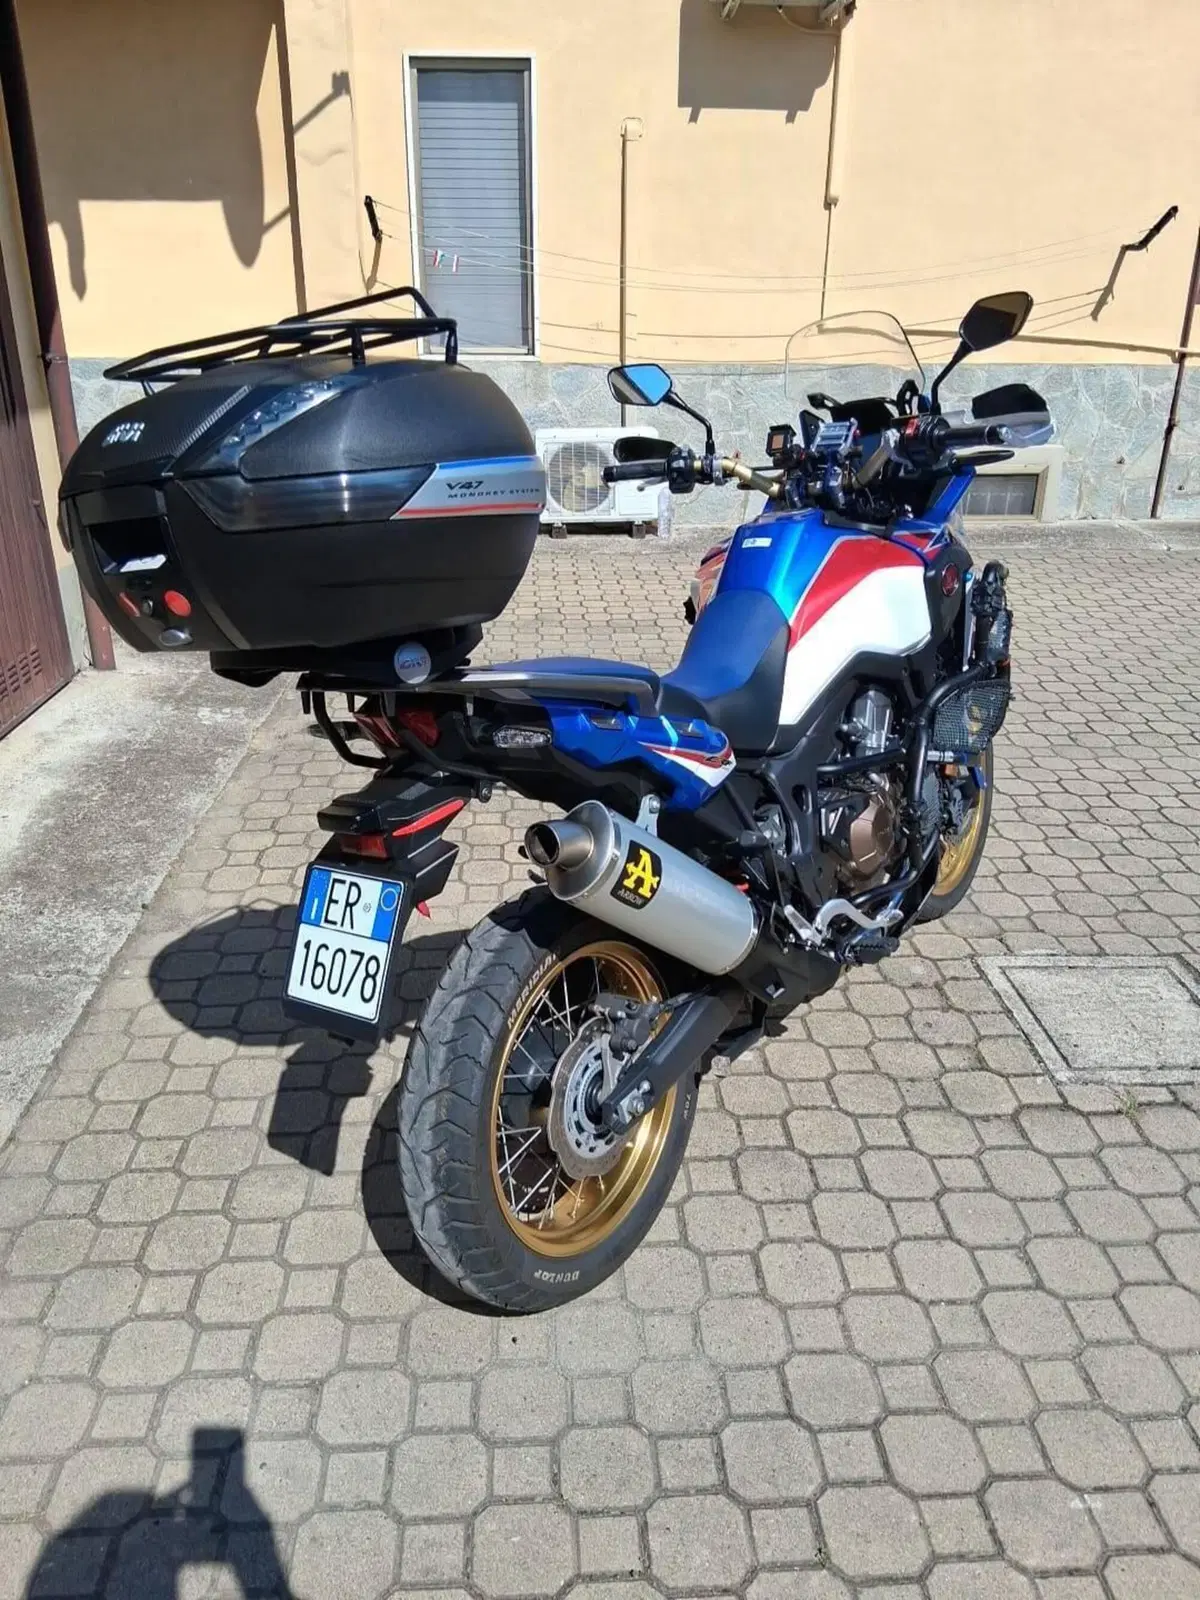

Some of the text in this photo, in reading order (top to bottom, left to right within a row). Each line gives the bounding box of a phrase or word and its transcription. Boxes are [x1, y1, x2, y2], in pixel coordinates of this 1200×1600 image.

[446, 480, 484, 490] V47
[447, 490, 506, 499] MONOKEY
[323, 878, 361, 930] ER
[617, 888, 644, 905] ARROW
[299, 940, 381, 1004] 16078
[533, 1268, 581, 1284] DUNLOP
